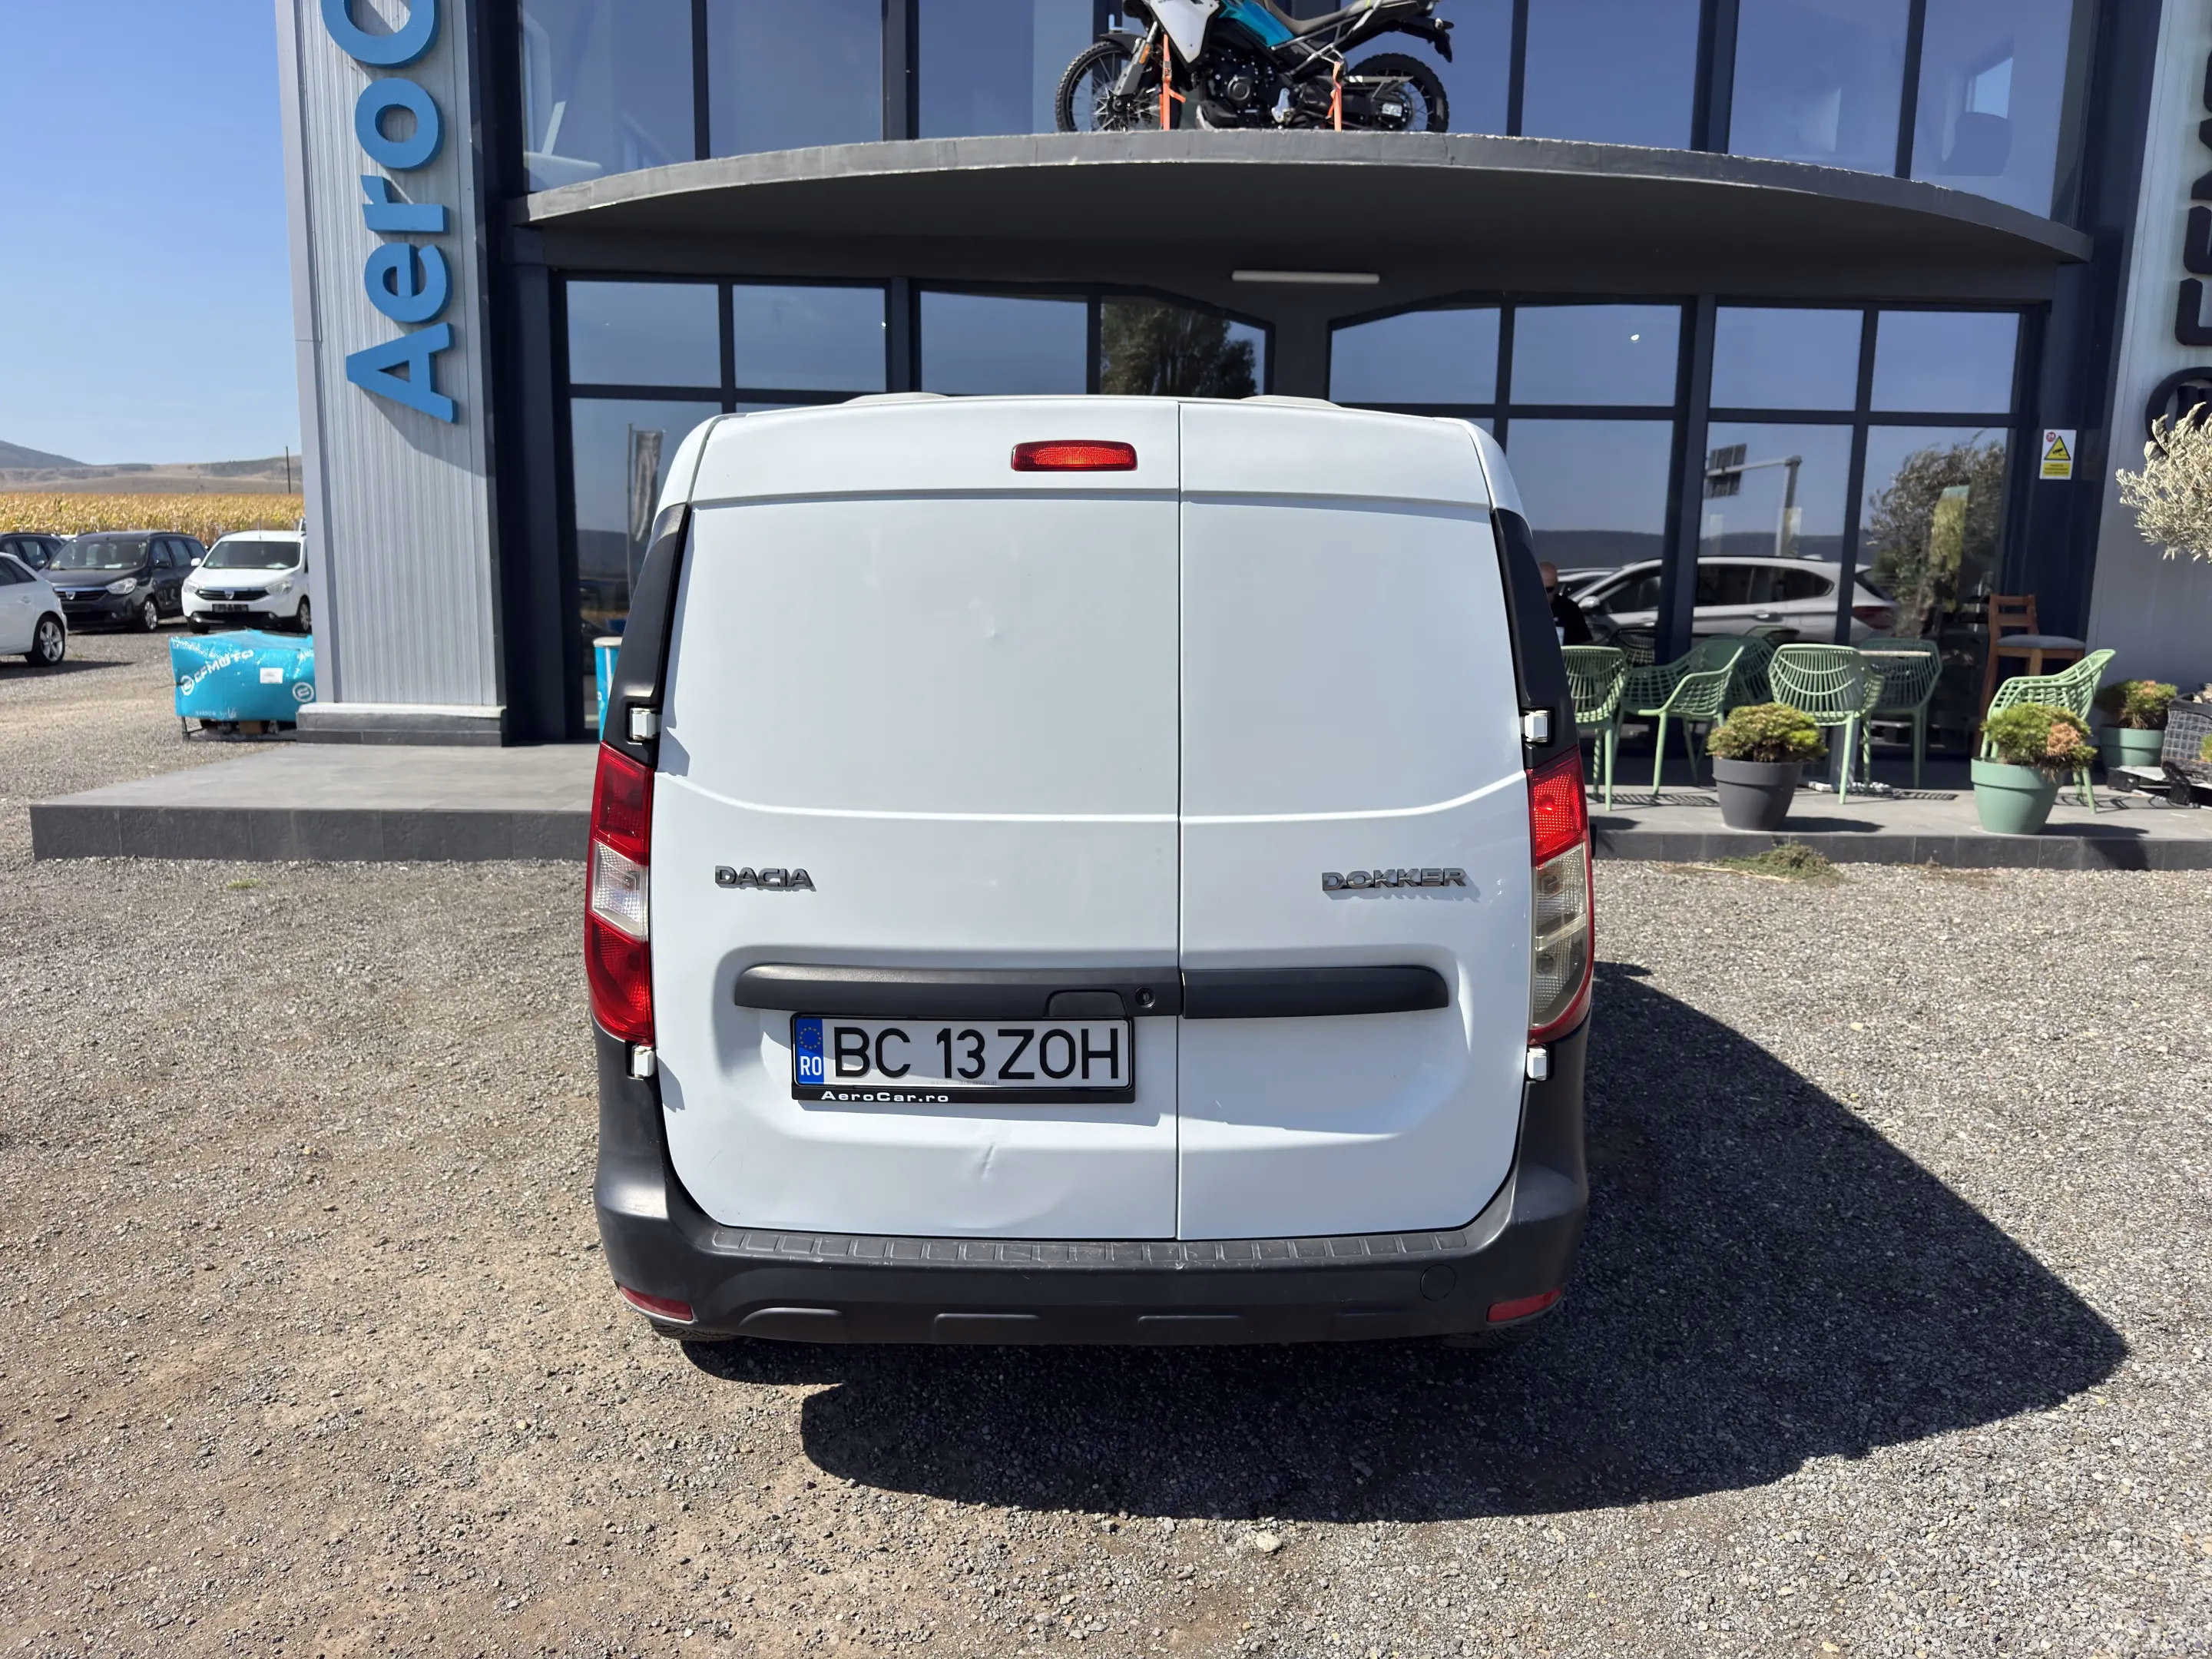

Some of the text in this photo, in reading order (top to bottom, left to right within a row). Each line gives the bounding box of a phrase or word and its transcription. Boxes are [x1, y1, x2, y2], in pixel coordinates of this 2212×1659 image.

[714, 865, 816, 891] DACIA
[1321, 867, 1468, 892] DOKKER
[834, 1027, 910, 1078] BC
[800, 1055, 822, 1076] RO
[821, 1090, 949, 1102] AeroCar.ro
